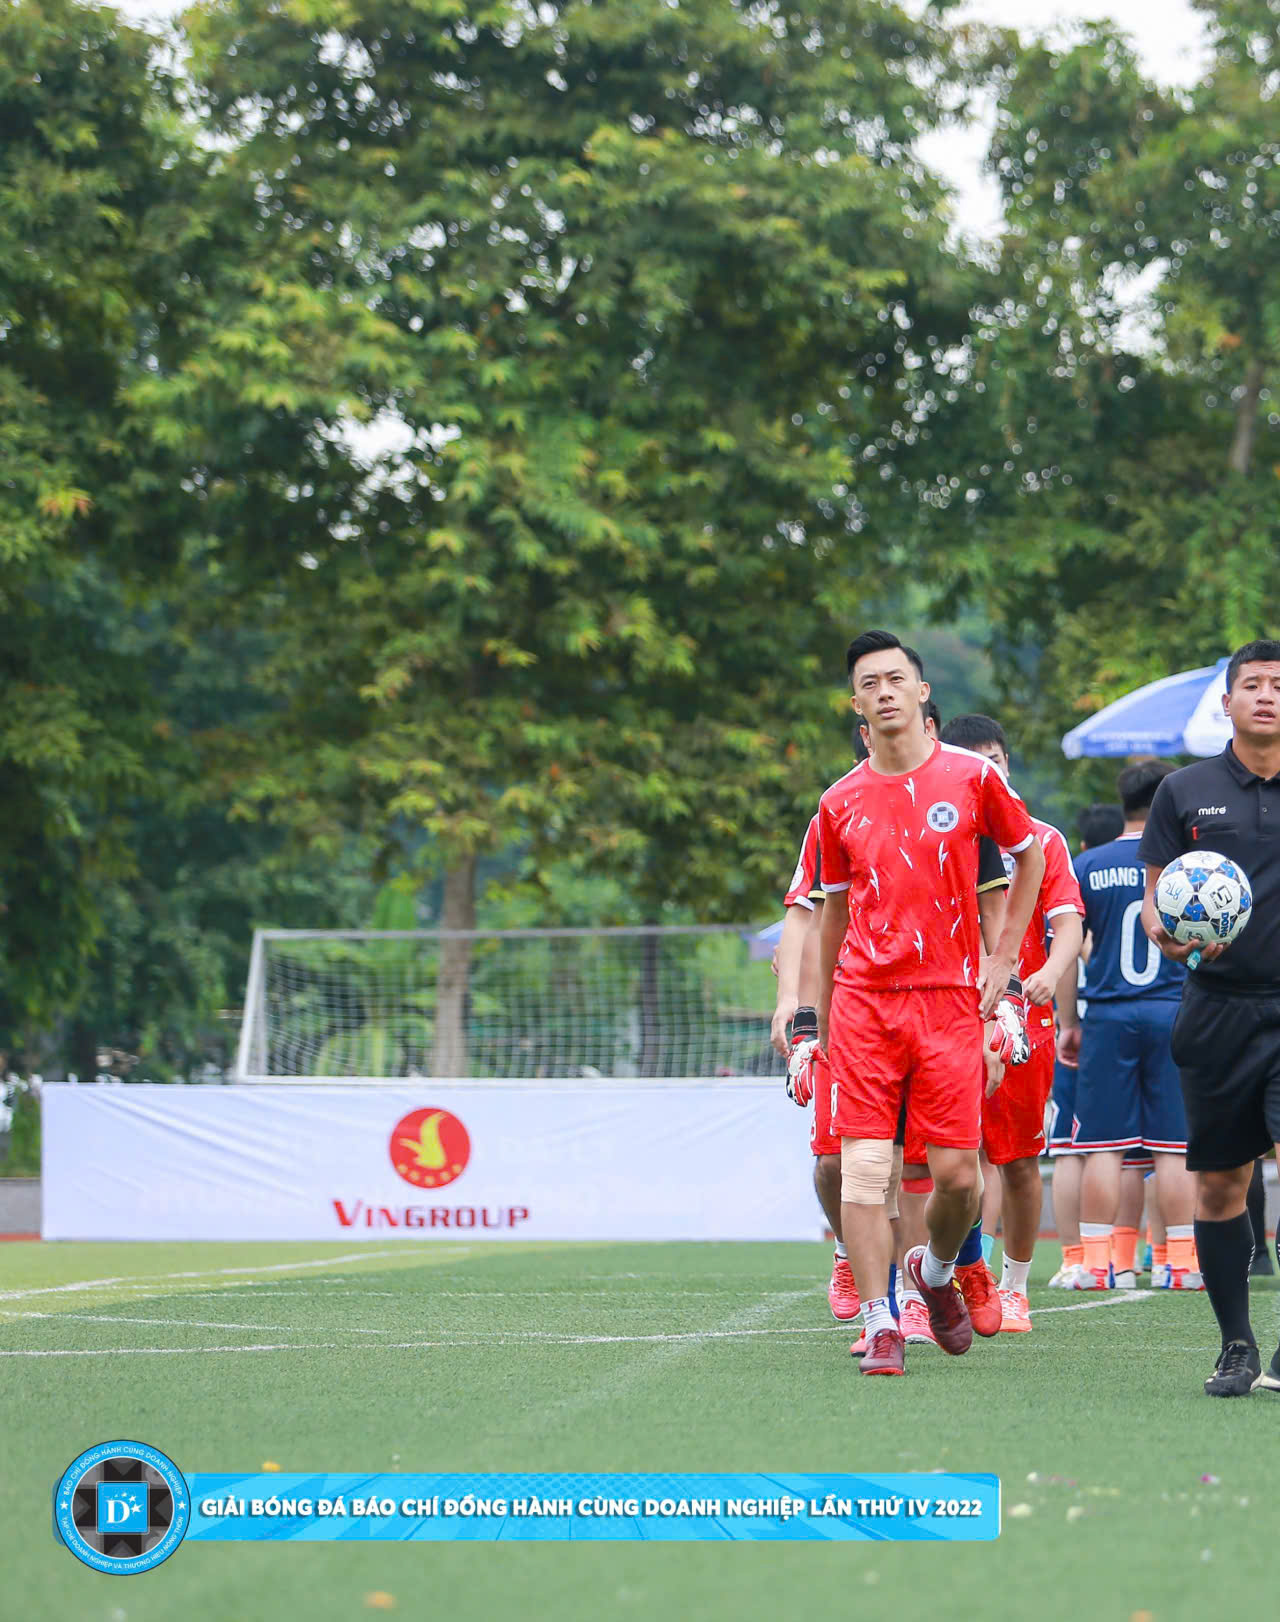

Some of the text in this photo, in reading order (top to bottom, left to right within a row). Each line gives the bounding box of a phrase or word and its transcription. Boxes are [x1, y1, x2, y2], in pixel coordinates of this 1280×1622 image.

[1198, 806, 1227, 816] mitre
[1088, 866, 1139, 891] QUANG
[332, 1199, 530, 1228] VINGROUP
